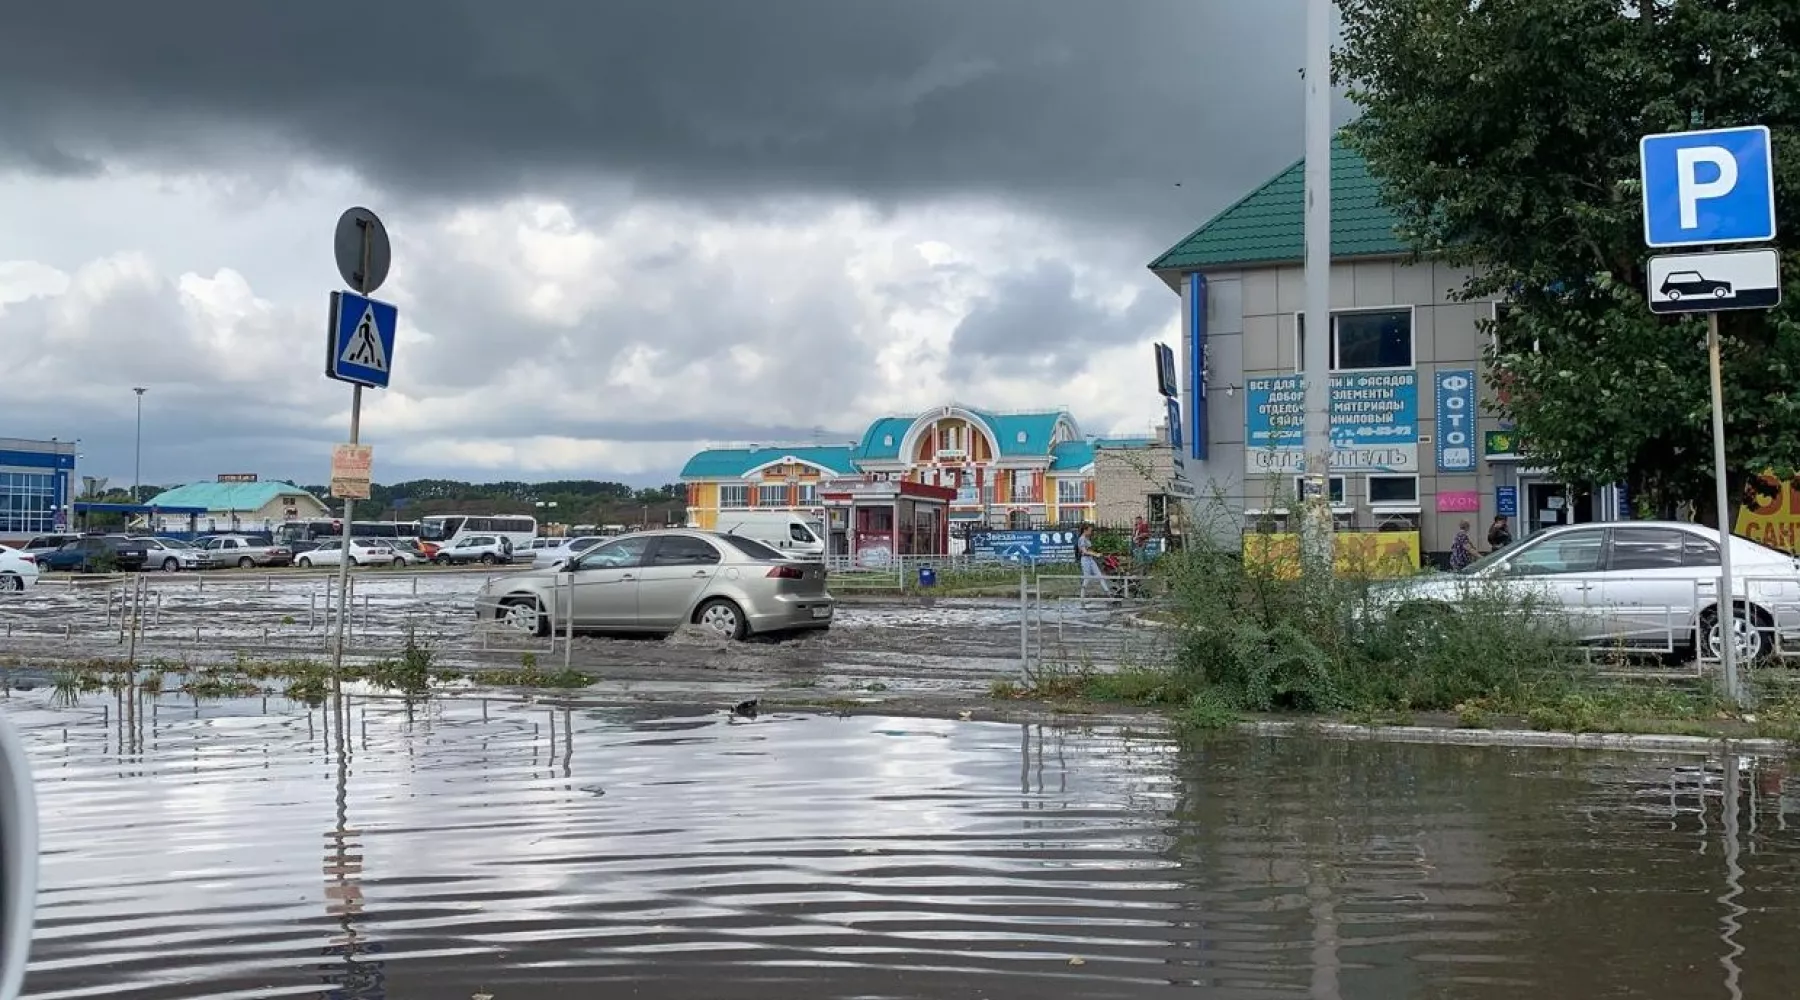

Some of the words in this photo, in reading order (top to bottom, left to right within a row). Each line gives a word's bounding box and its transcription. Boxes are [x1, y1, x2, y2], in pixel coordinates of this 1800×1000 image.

[1676, 145, 1738, 229] P
[1250, 380, 1270, 390] ВСЕ
[1274, 379, 1295, 391] ДЛЯ
[1358, 375, 1413, 387] ФАСАДОВ
[1332, 388, 1394, 400] ЭЛЕМЕНТЫ
[1334, 400, 1404, 412] МАТЕРИАЛЫ
[1442, 375, 1468, 444] ФОТО
[1330, 412, 1394, 425] ИНИЛОВЫЙ
[1438, 496, 1478, 507] AVON
